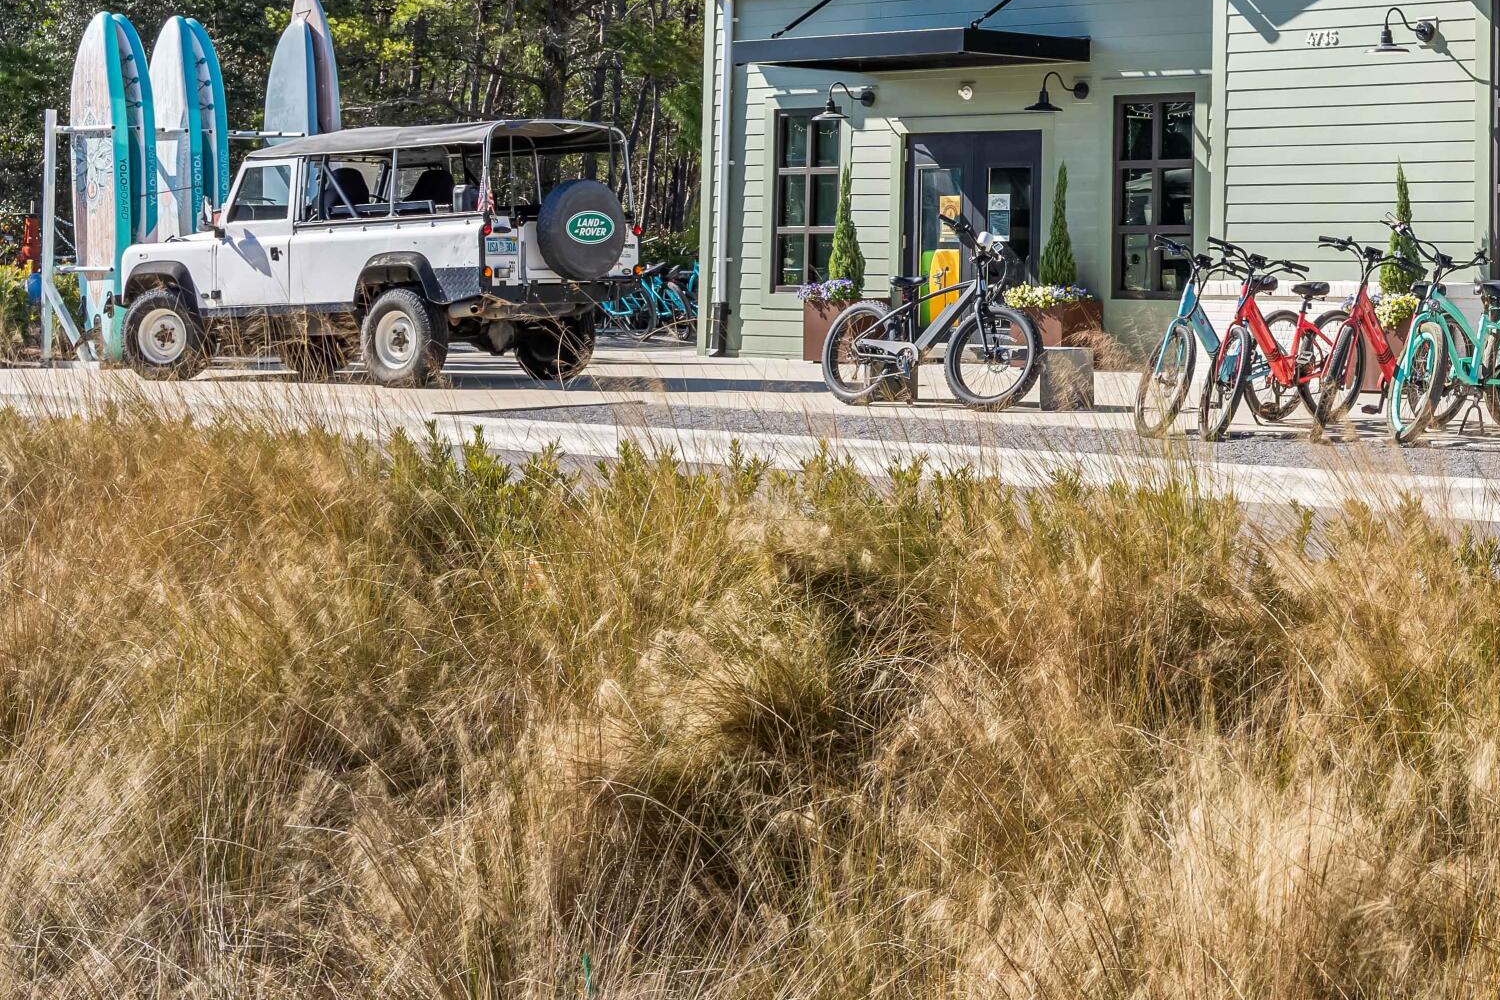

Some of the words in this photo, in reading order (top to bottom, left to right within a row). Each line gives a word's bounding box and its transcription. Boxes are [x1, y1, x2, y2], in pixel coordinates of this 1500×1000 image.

[119, 159, 129, 220] YOLOBOARD
[577, 217, 600, 227] LAND
[579, 227, 607, 237] ROVER
